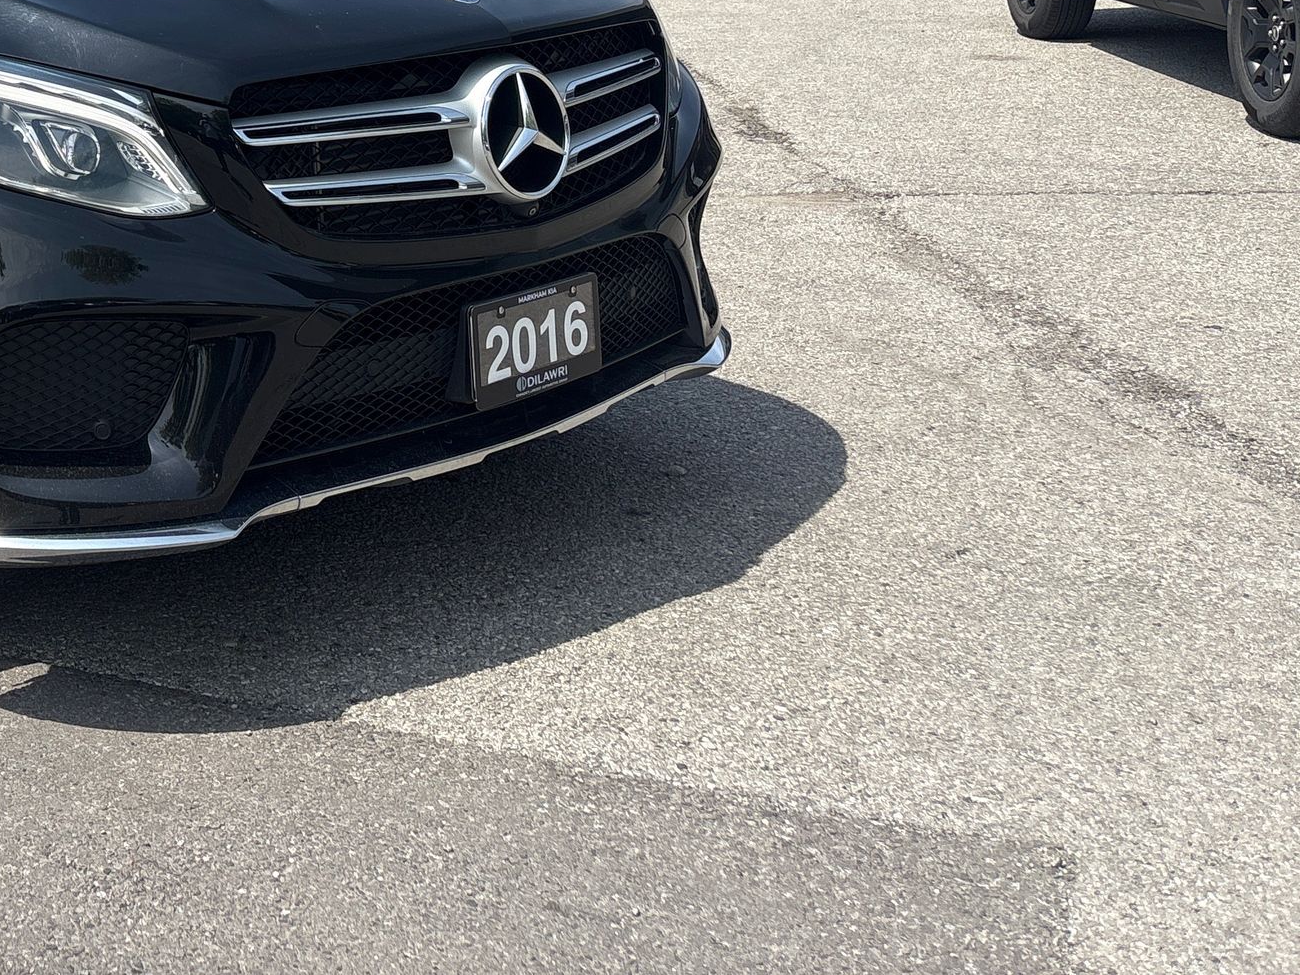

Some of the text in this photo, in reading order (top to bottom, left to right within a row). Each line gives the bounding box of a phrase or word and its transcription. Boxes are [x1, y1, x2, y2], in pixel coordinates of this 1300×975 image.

[518, 286, 558, 303] MARKHAM KIA
[485, 300, 589, 385] 2016
[527, 364, 568, 387] DILAWRI
